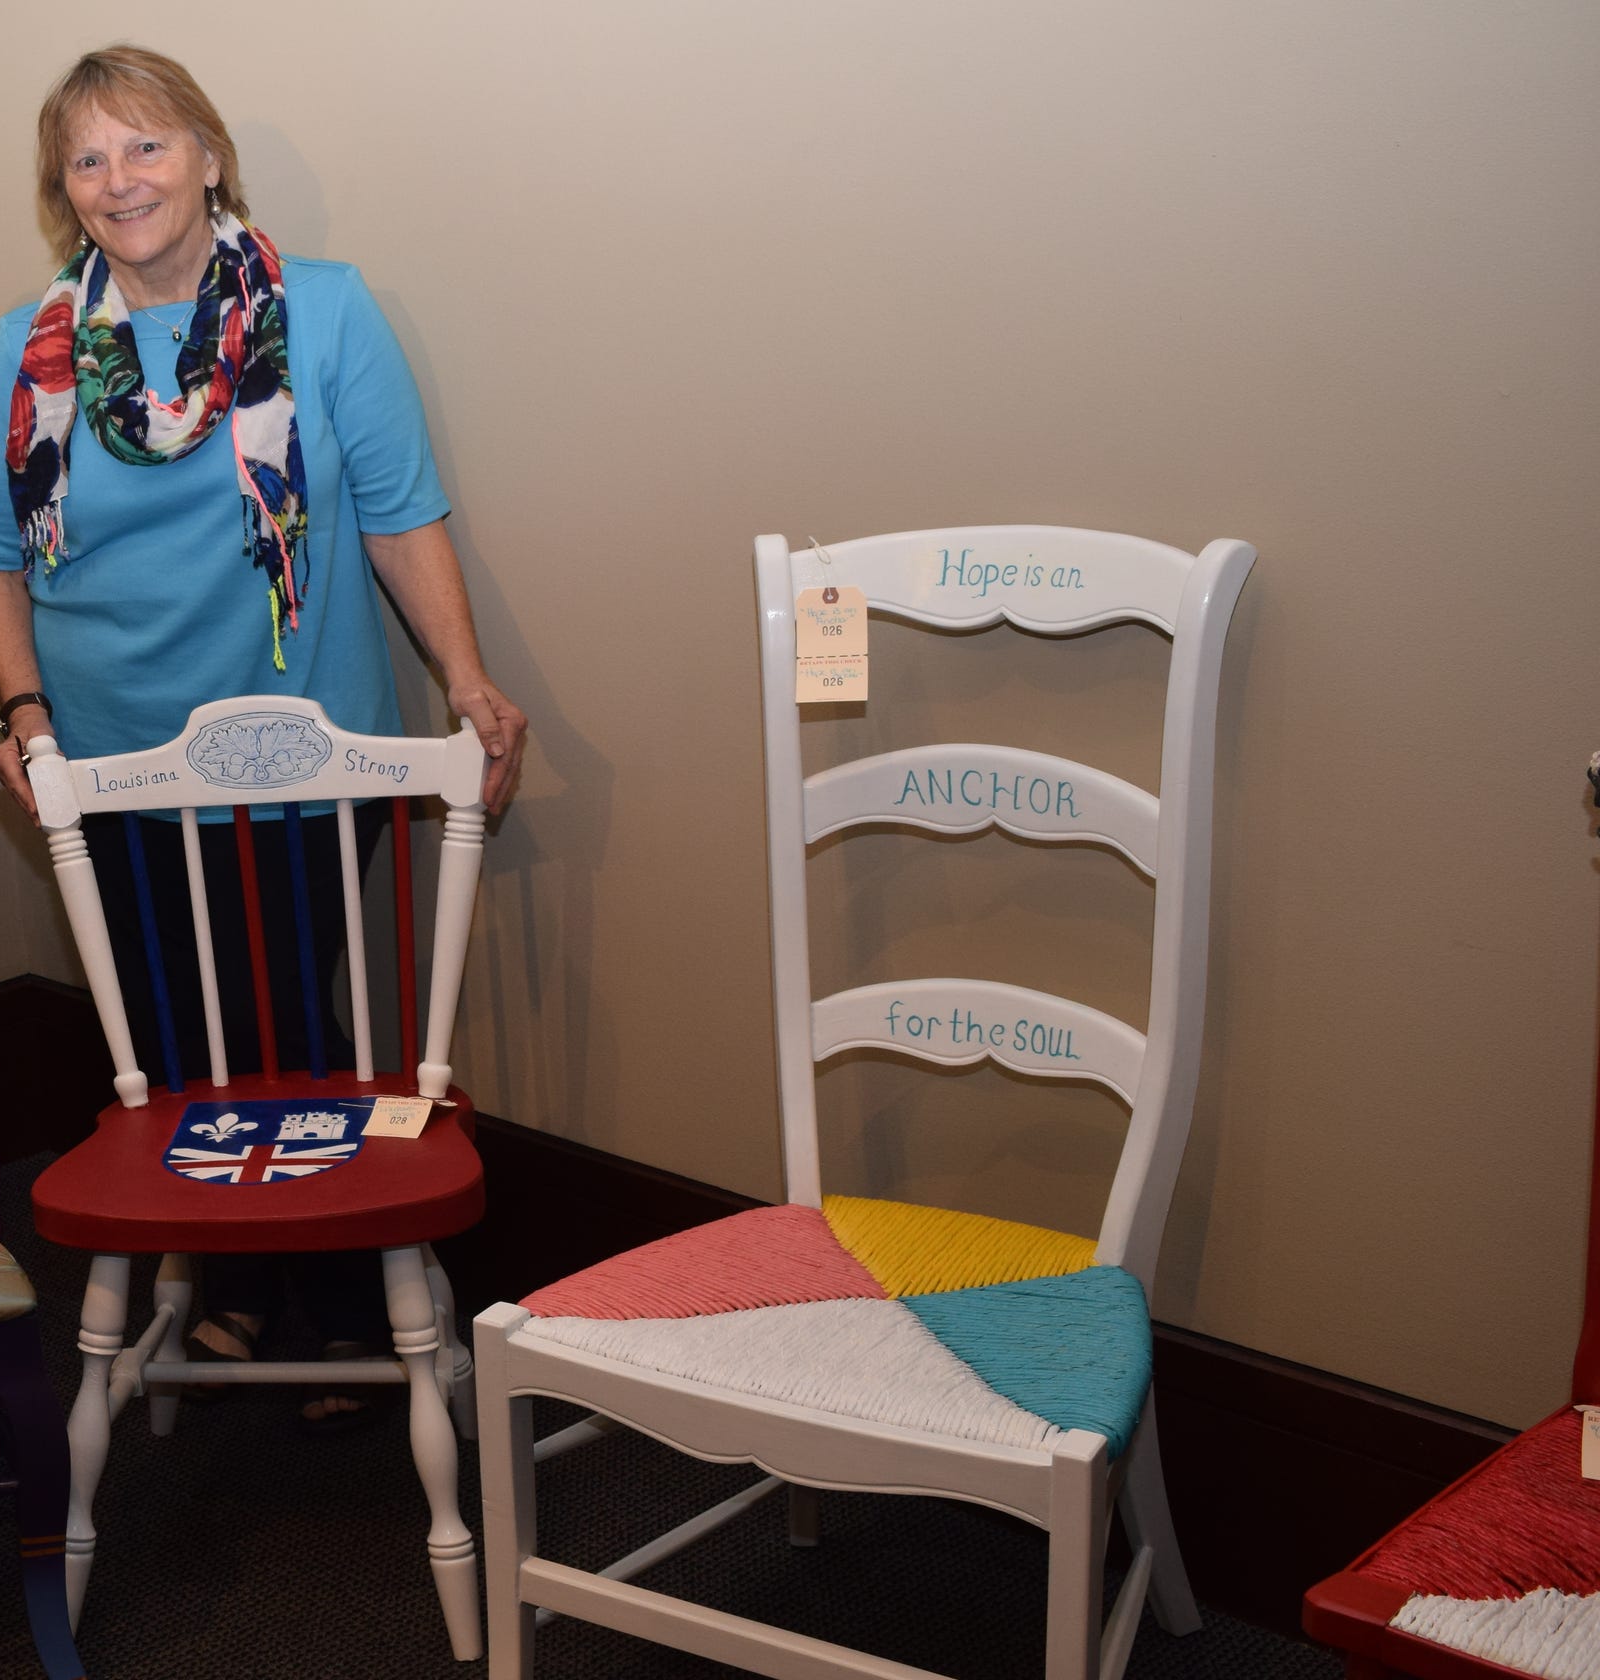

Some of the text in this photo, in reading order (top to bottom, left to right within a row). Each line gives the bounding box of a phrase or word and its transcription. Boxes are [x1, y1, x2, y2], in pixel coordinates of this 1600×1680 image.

[936, 549, 1084, 598] Hope is an
[822, 625, 843, 636] 026
[823, 677, 844, 687] 026
[89, 749, 409, 793] Louisiana Strong
[894, 769, 1082, 818] ANCHOR
[885, 1001, 1081, 1060] for the SOUL
[390, 1116, 407, 1124] 028
